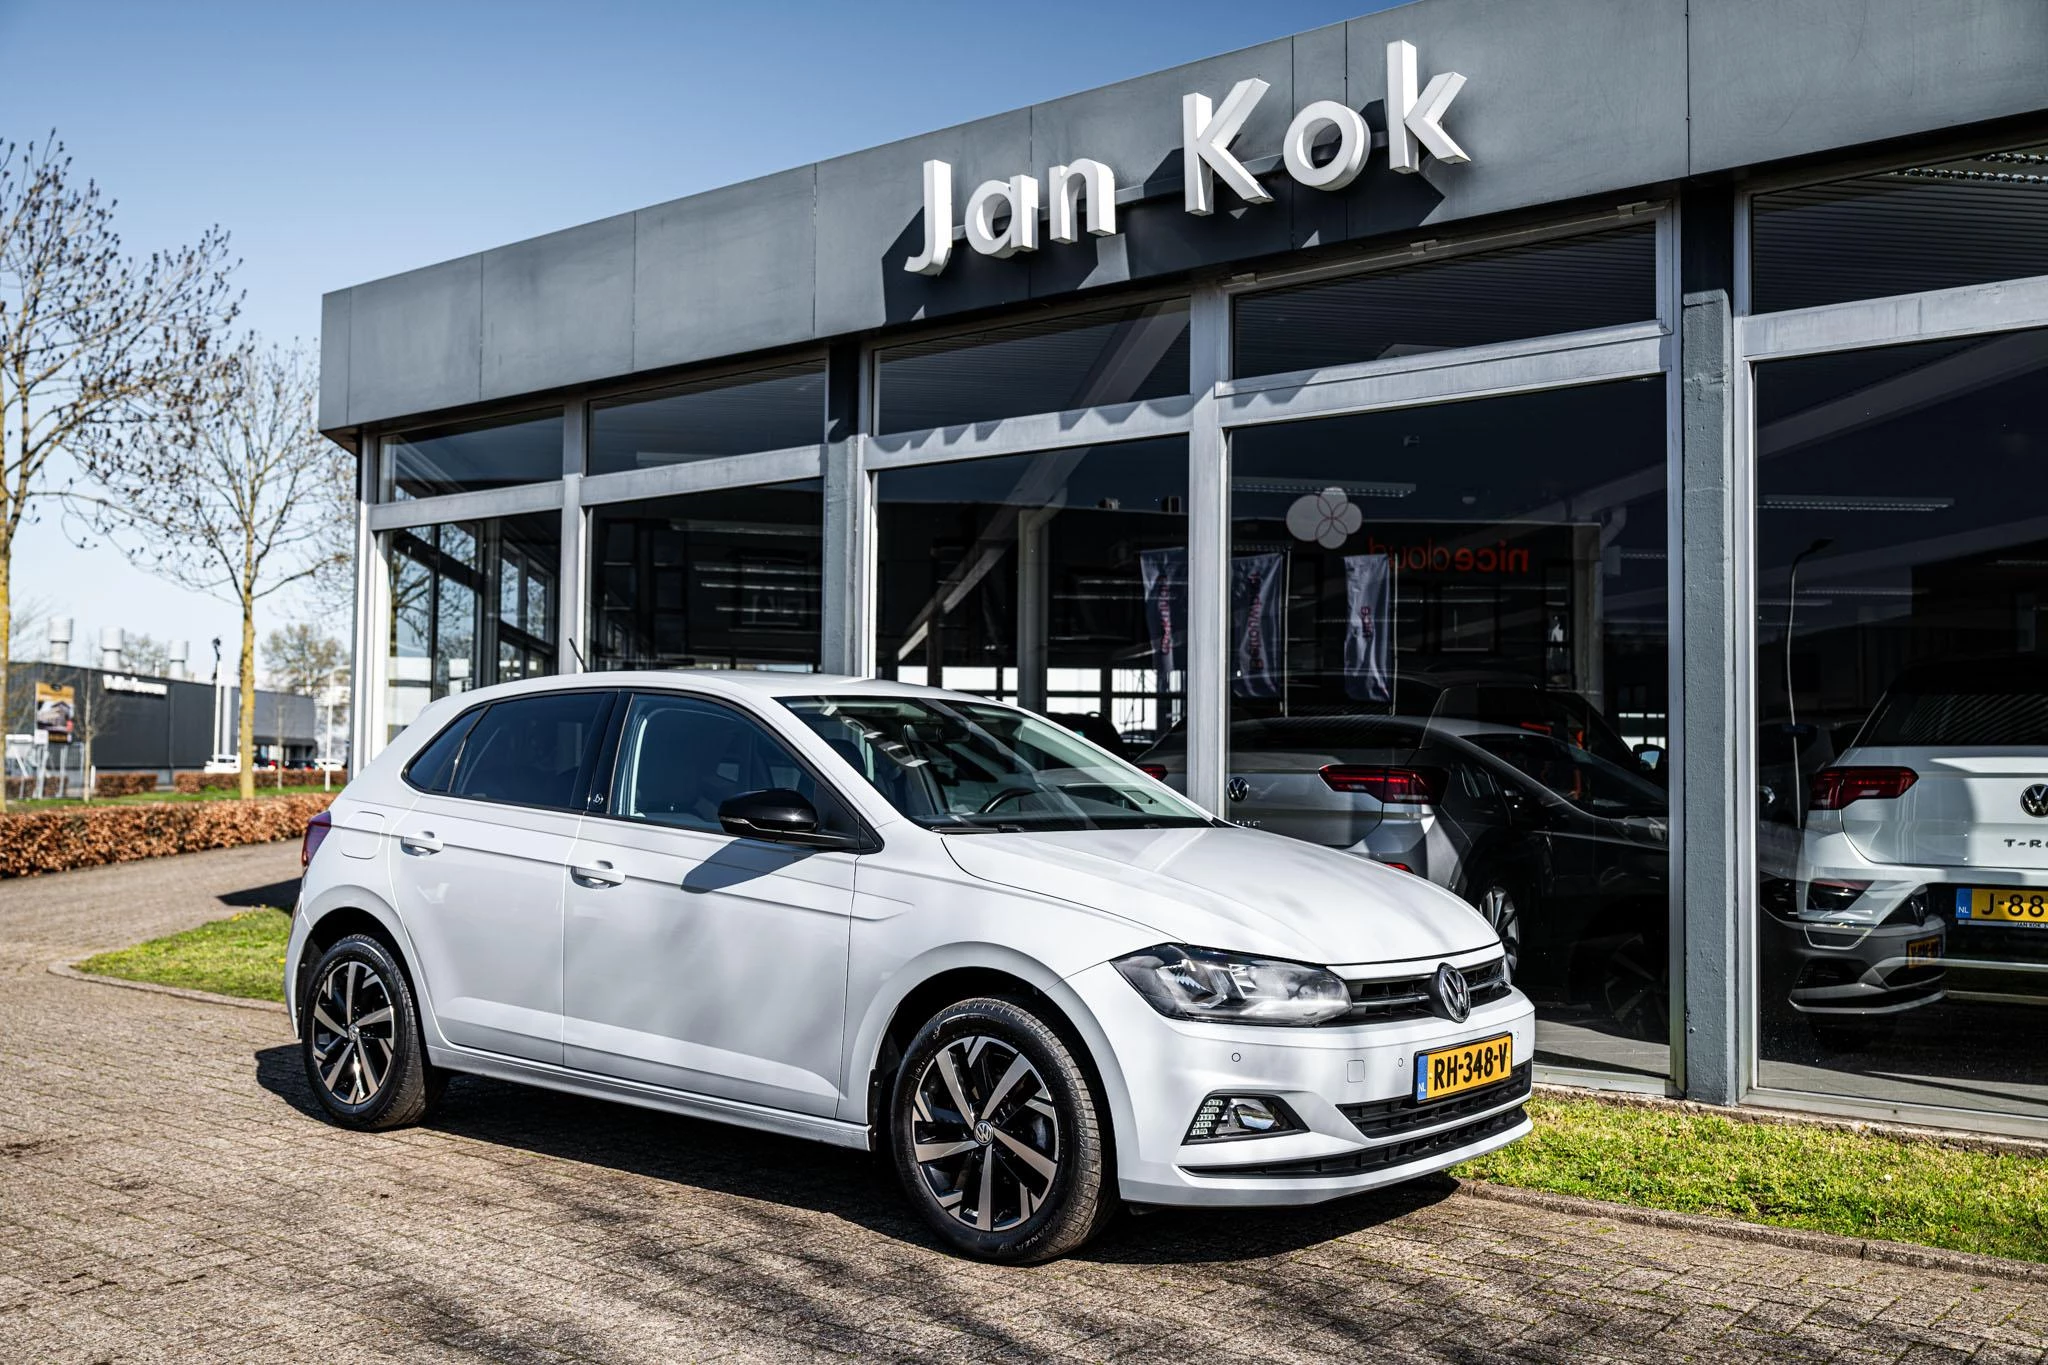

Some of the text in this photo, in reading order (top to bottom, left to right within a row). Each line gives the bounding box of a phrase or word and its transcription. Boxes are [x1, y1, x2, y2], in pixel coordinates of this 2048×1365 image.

[904, 39, 1471, 277] Jan Kok
[2003, 838, 2048, 848] T-R
[1958, 906, 1969, 914] NL
[1418, 1042, 1507, 1093] NL RH-348-V
